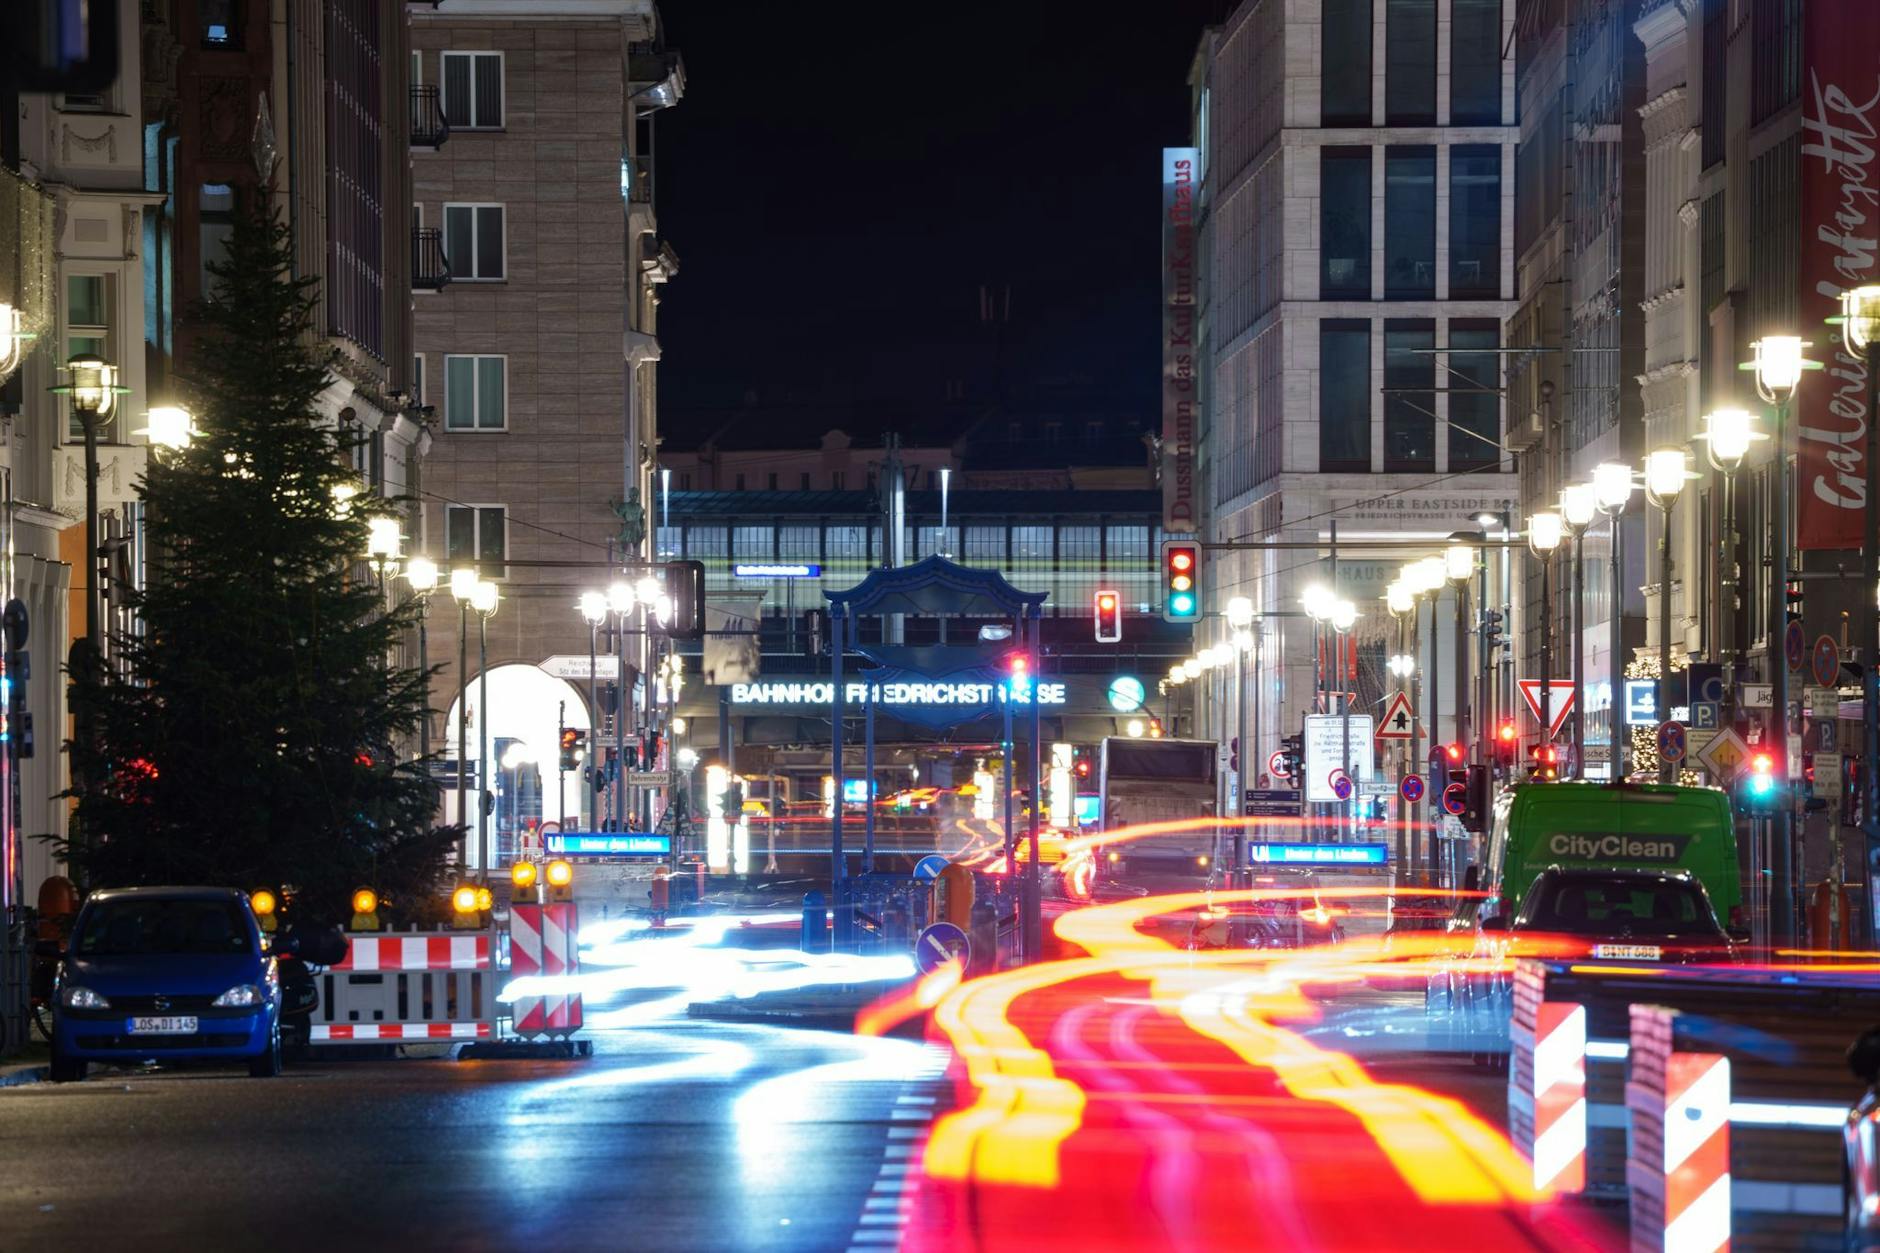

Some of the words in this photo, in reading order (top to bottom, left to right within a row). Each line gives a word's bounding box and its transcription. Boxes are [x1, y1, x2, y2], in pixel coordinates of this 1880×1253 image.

[1171, 354, 1192, 392] das
[1171, 401, 1192, 522] Dussmann
[1355, 499, 1405, 510] UPPER
[1412, 499, 1487, 510] EASTSIDE
[1550, 834, 1676, 858] CityClean
